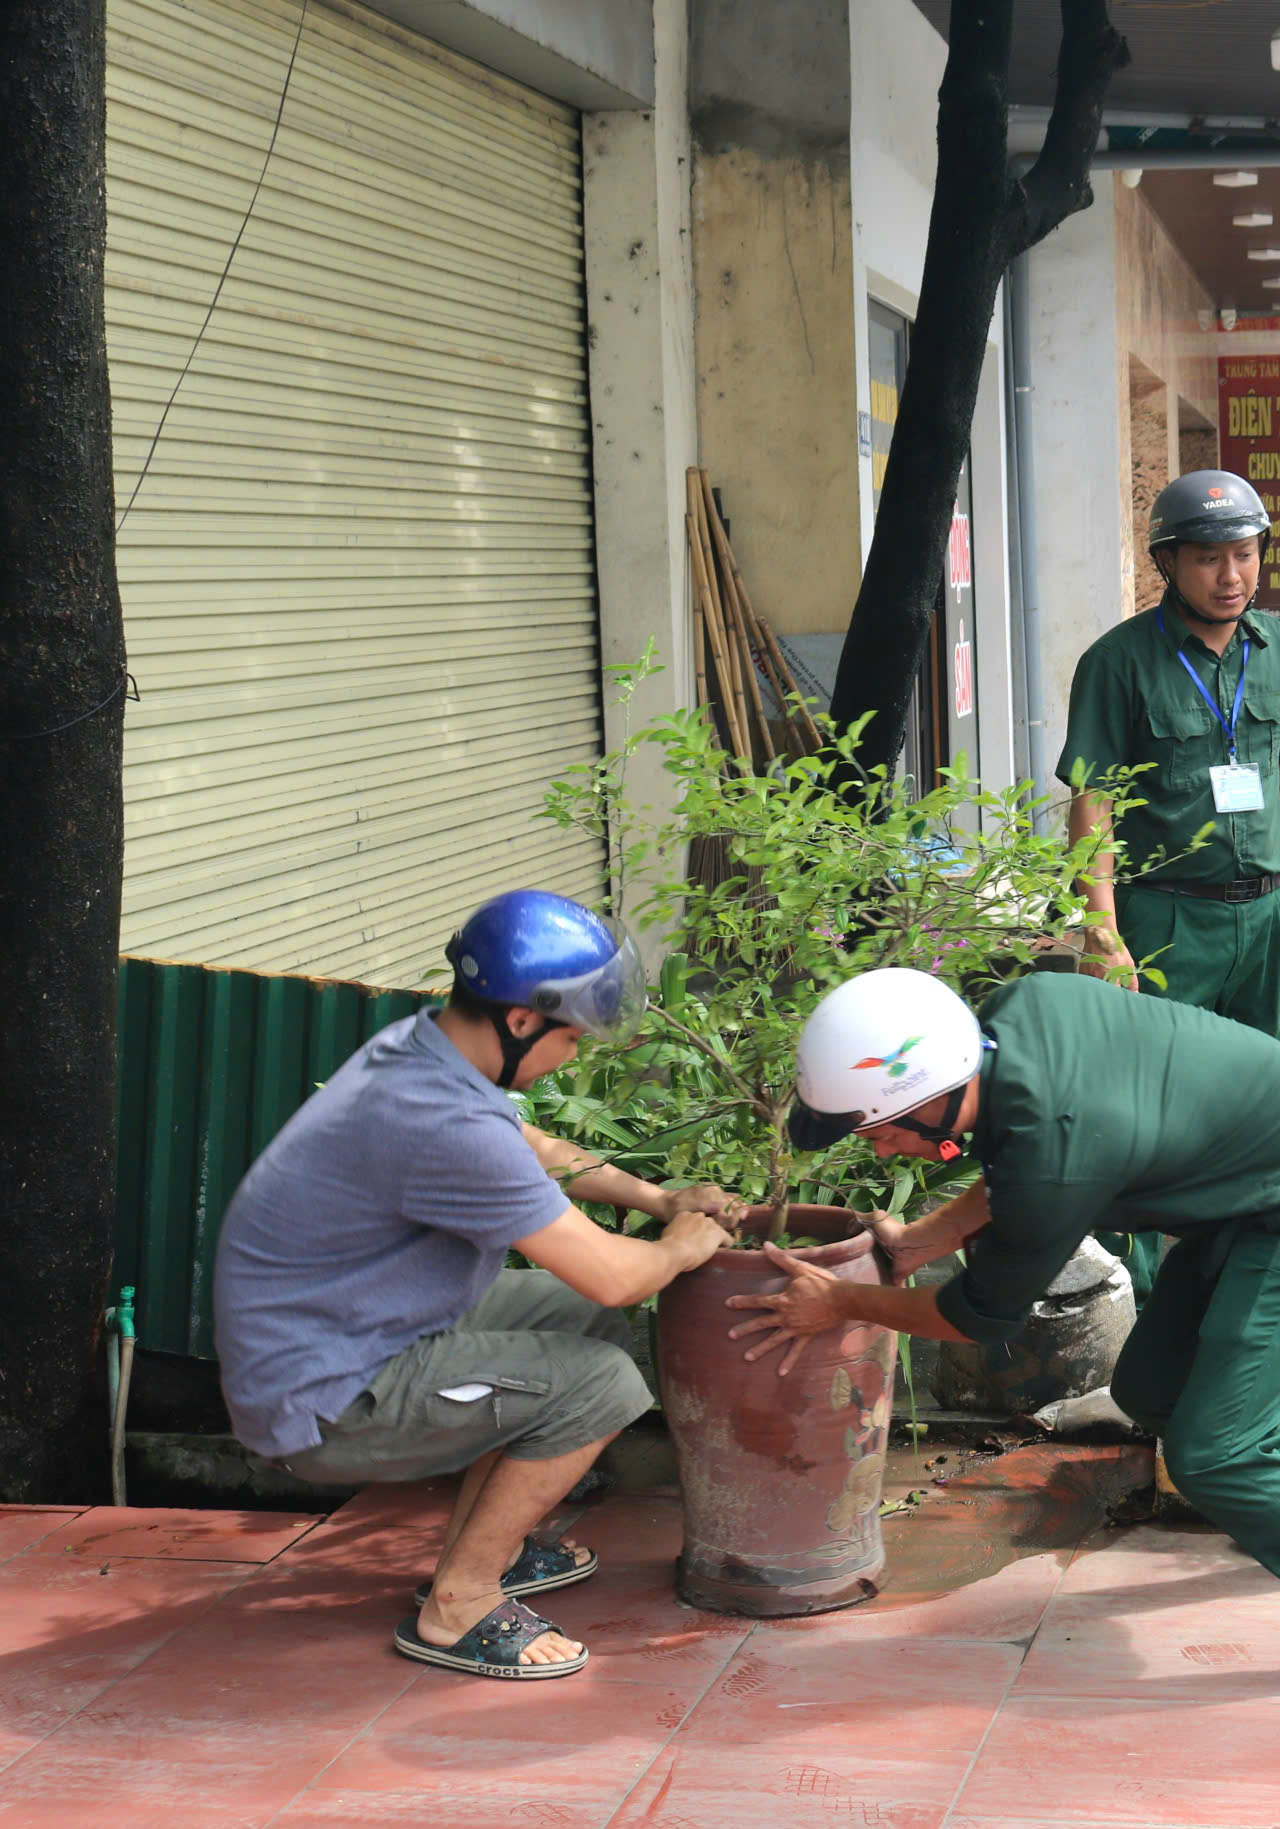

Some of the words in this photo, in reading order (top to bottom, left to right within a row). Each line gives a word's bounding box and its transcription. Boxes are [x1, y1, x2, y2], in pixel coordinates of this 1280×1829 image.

[1228, 388, 1273, 445] ĐIỆN
[1203, 498, 1235, 511] YADEA
[477, 1664, 521, 1677] crocs
